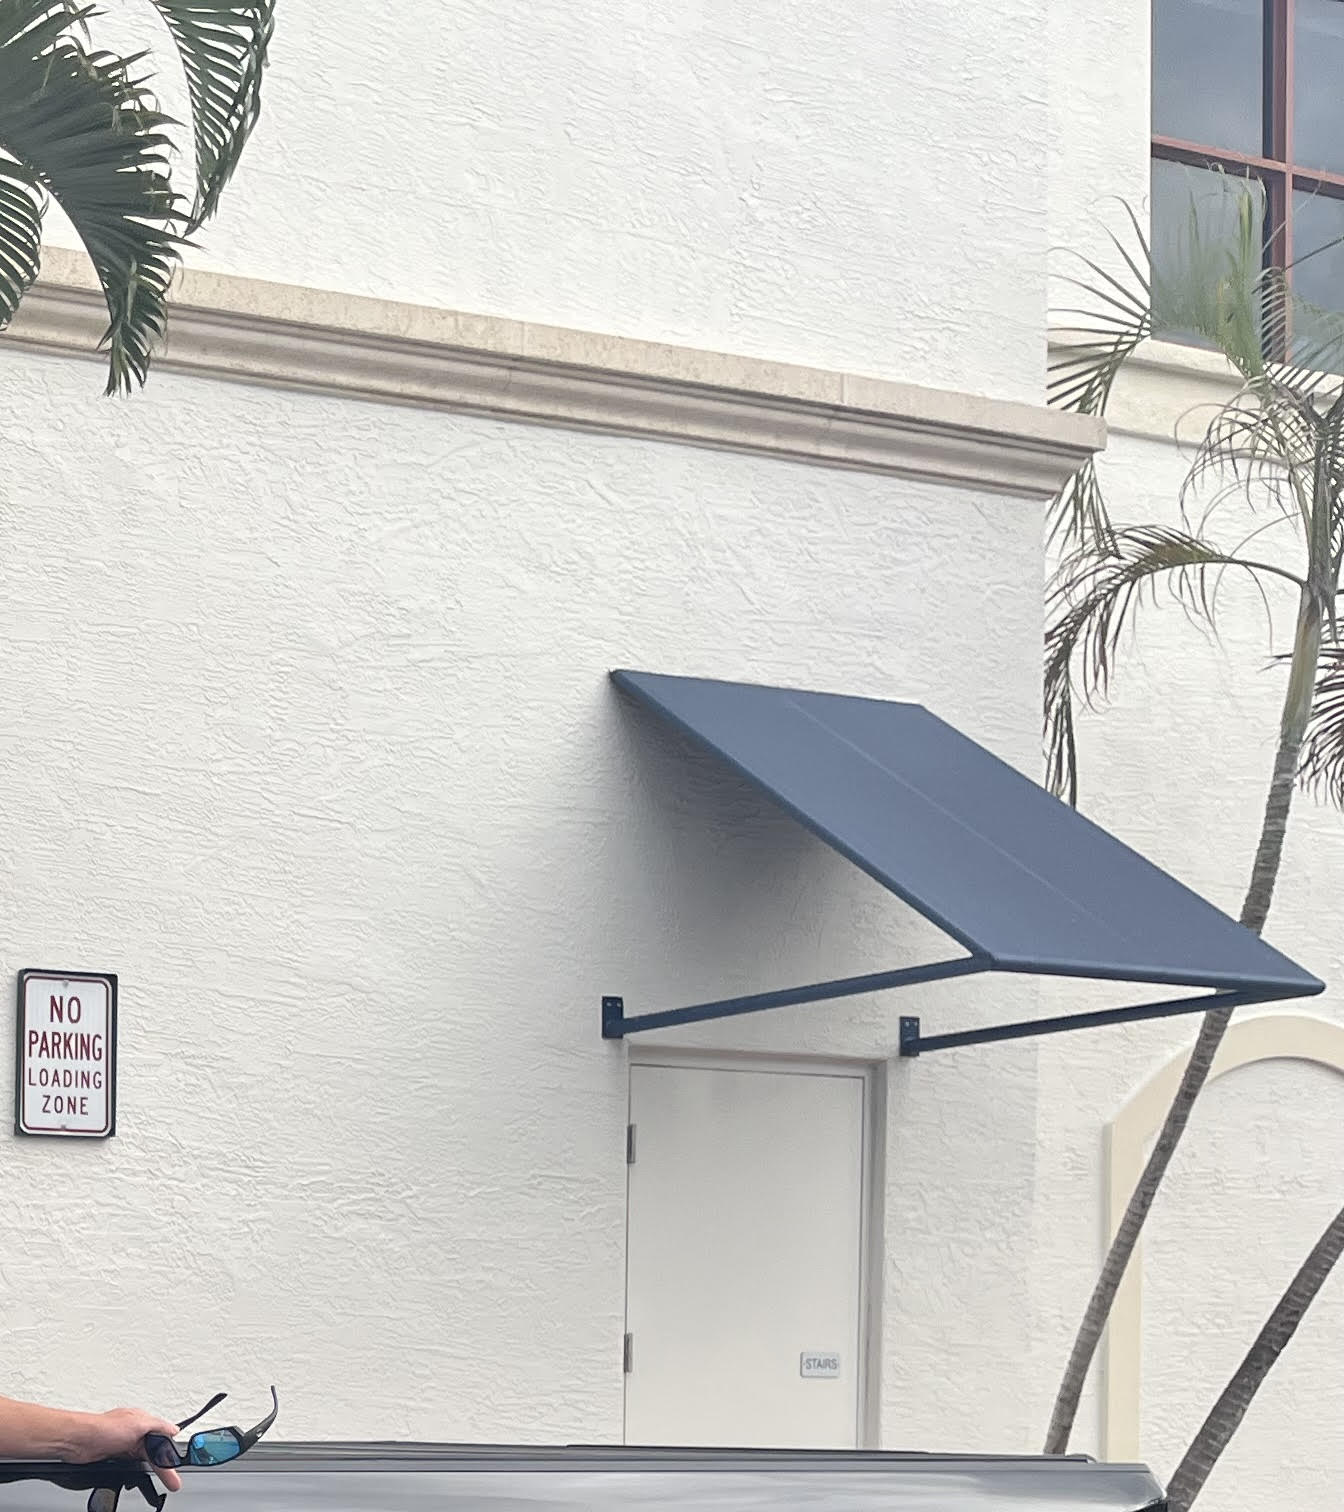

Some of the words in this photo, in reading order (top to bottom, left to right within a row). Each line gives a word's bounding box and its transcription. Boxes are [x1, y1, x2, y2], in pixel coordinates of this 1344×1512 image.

[50, 995, 81, 1024] NO
[28, 1030, 103, 1061] PARKING
[28, 1067, 102, 1089] LOADING
[42, 1095, 89, 1115] ZONE
[805, 1358, 838, 1370] STAIRS
